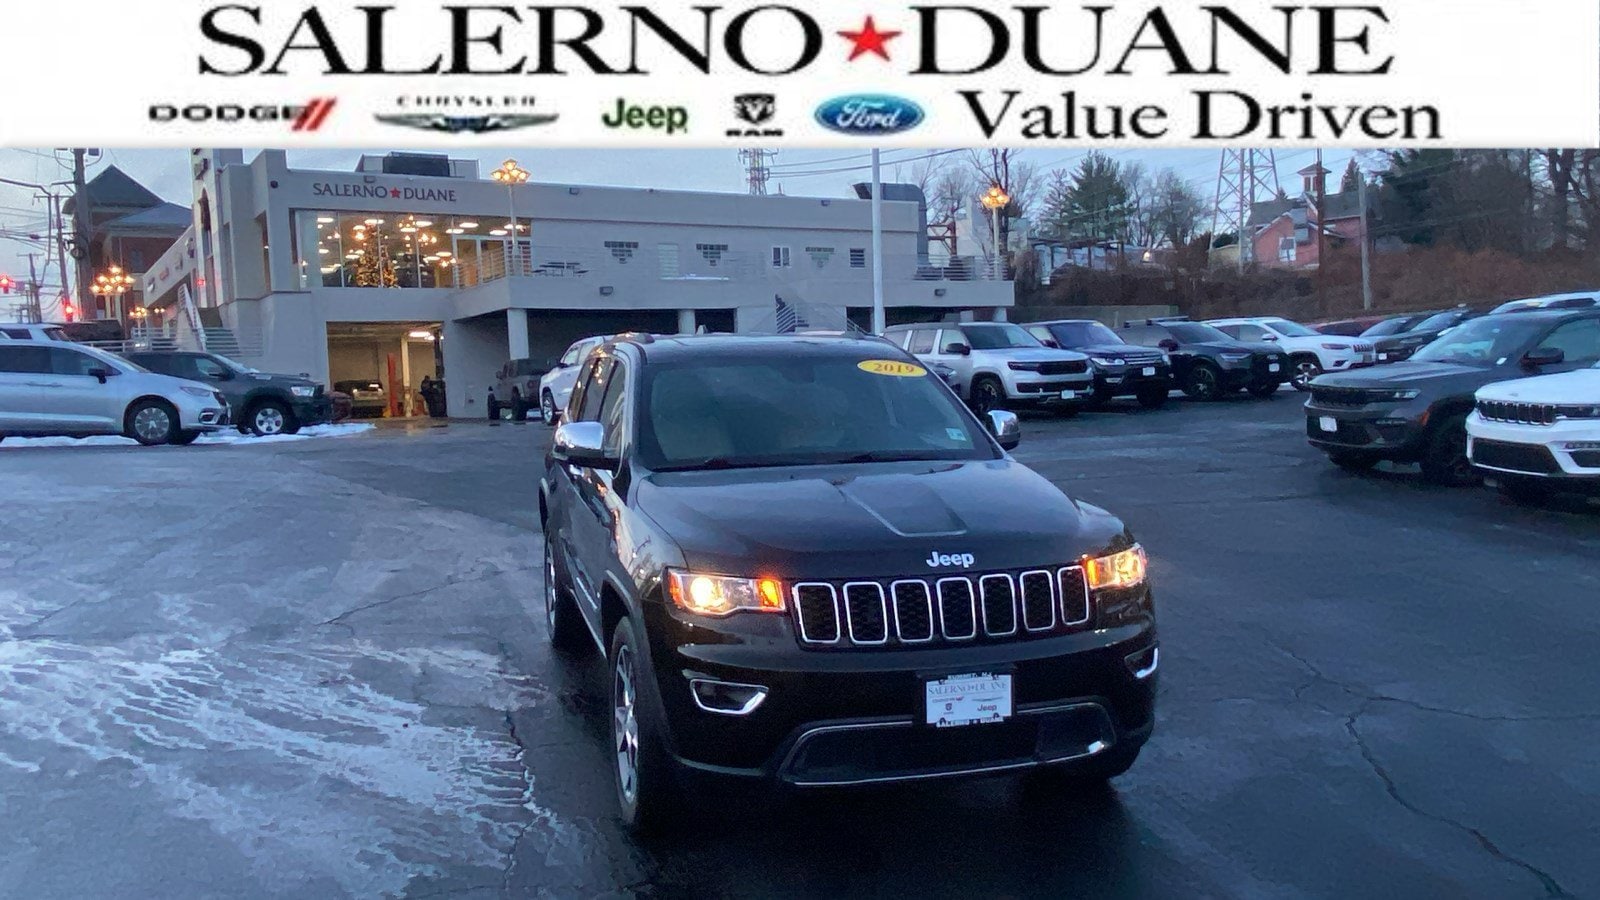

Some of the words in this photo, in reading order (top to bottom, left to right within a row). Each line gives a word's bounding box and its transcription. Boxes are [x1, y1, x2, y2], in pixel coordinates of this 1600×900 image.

[313, 183, 388, 198] SALERNO
[403, 187, 457, 202] DUANE
[873, 363, 915, 373] 2019
[926, 551, 974, 568] Jeep
[977, 704, 997, 712] Jeep
